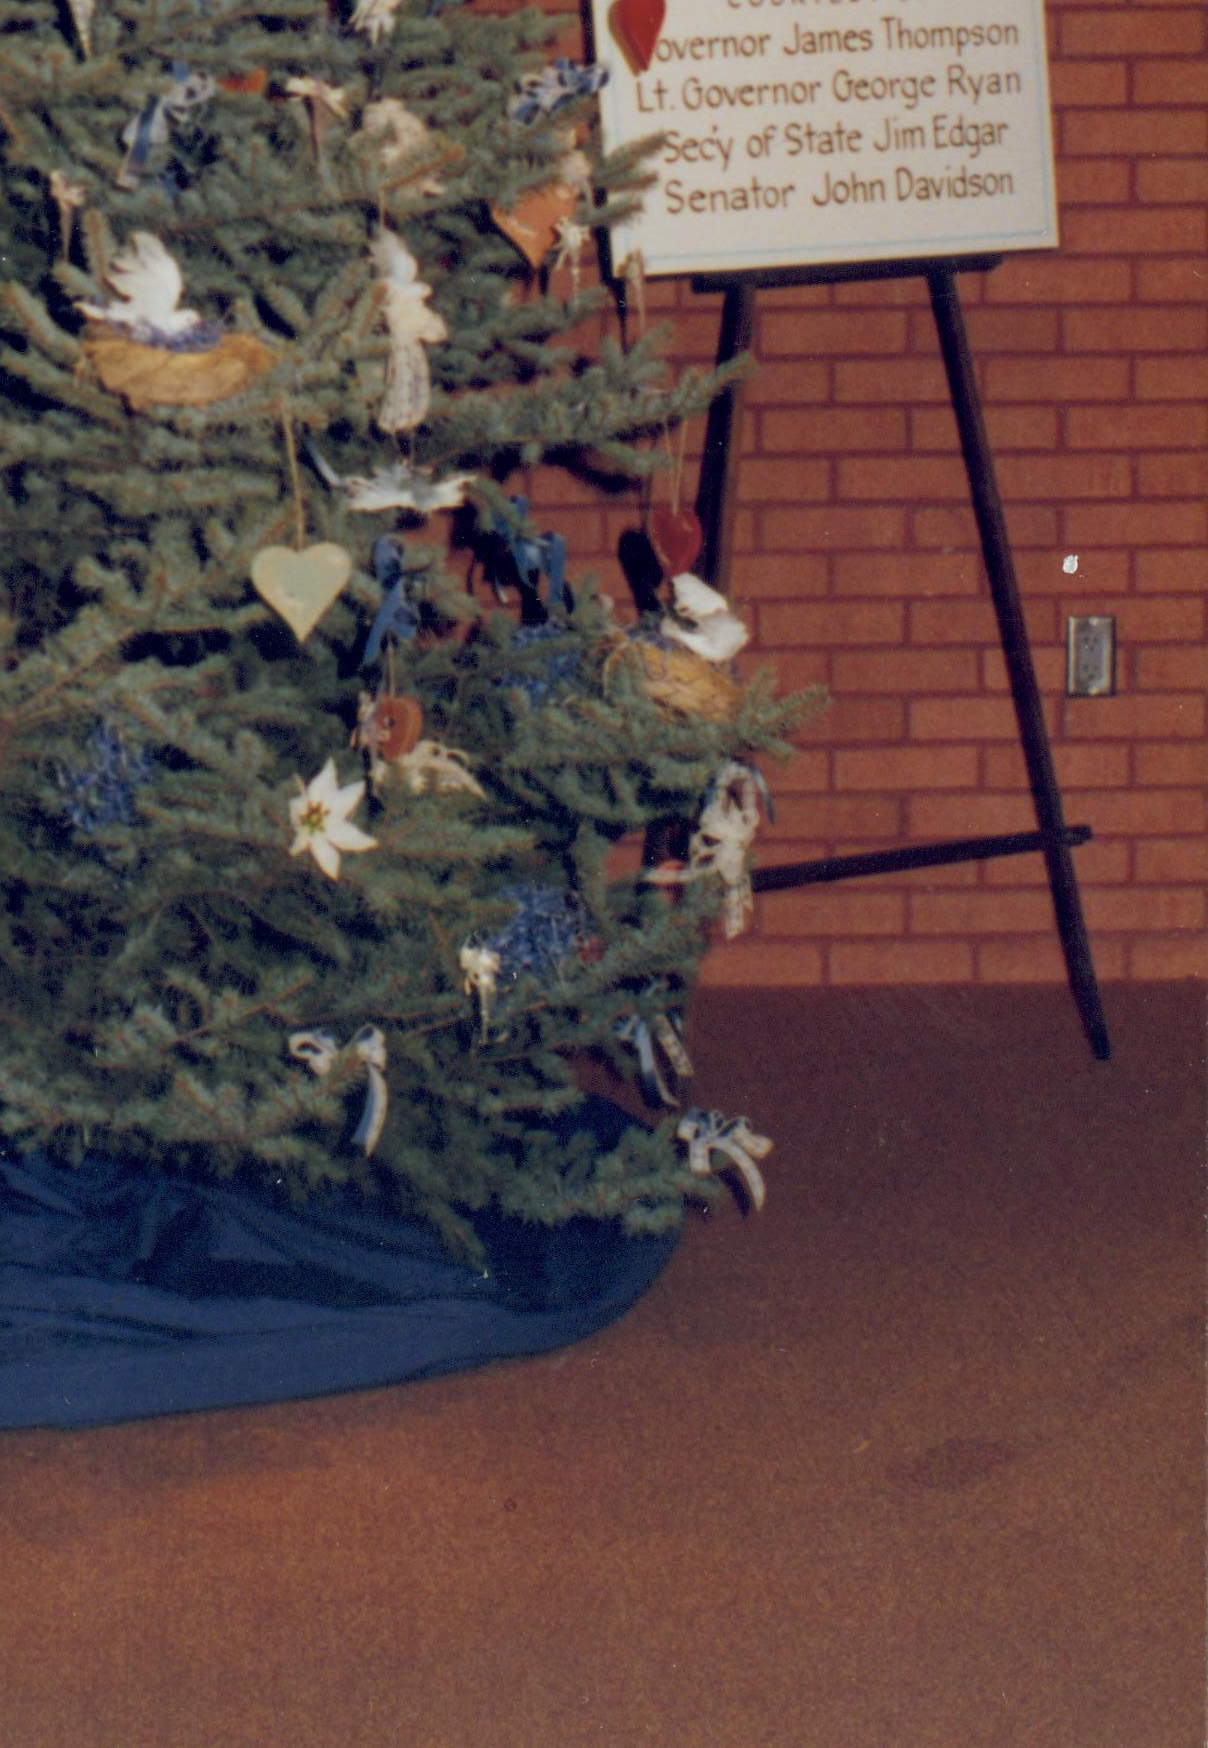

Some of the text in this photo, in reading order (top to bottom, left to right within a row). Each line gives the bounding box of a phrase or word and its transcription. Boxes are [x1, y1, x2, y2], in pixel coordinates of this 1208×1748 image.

[652, 16, 1020, 64] overnor James Thompson
[636, 64, 1022, 113] Lt. Governor George Ryan
[747, 128, 776, 158] of
[786, 120, 863, 157] State
[873, 116, 927, 154] Jim
[933, 114, 1009, 159] Edgar
[665, 165, 1015, 214] Senator John Davidson
